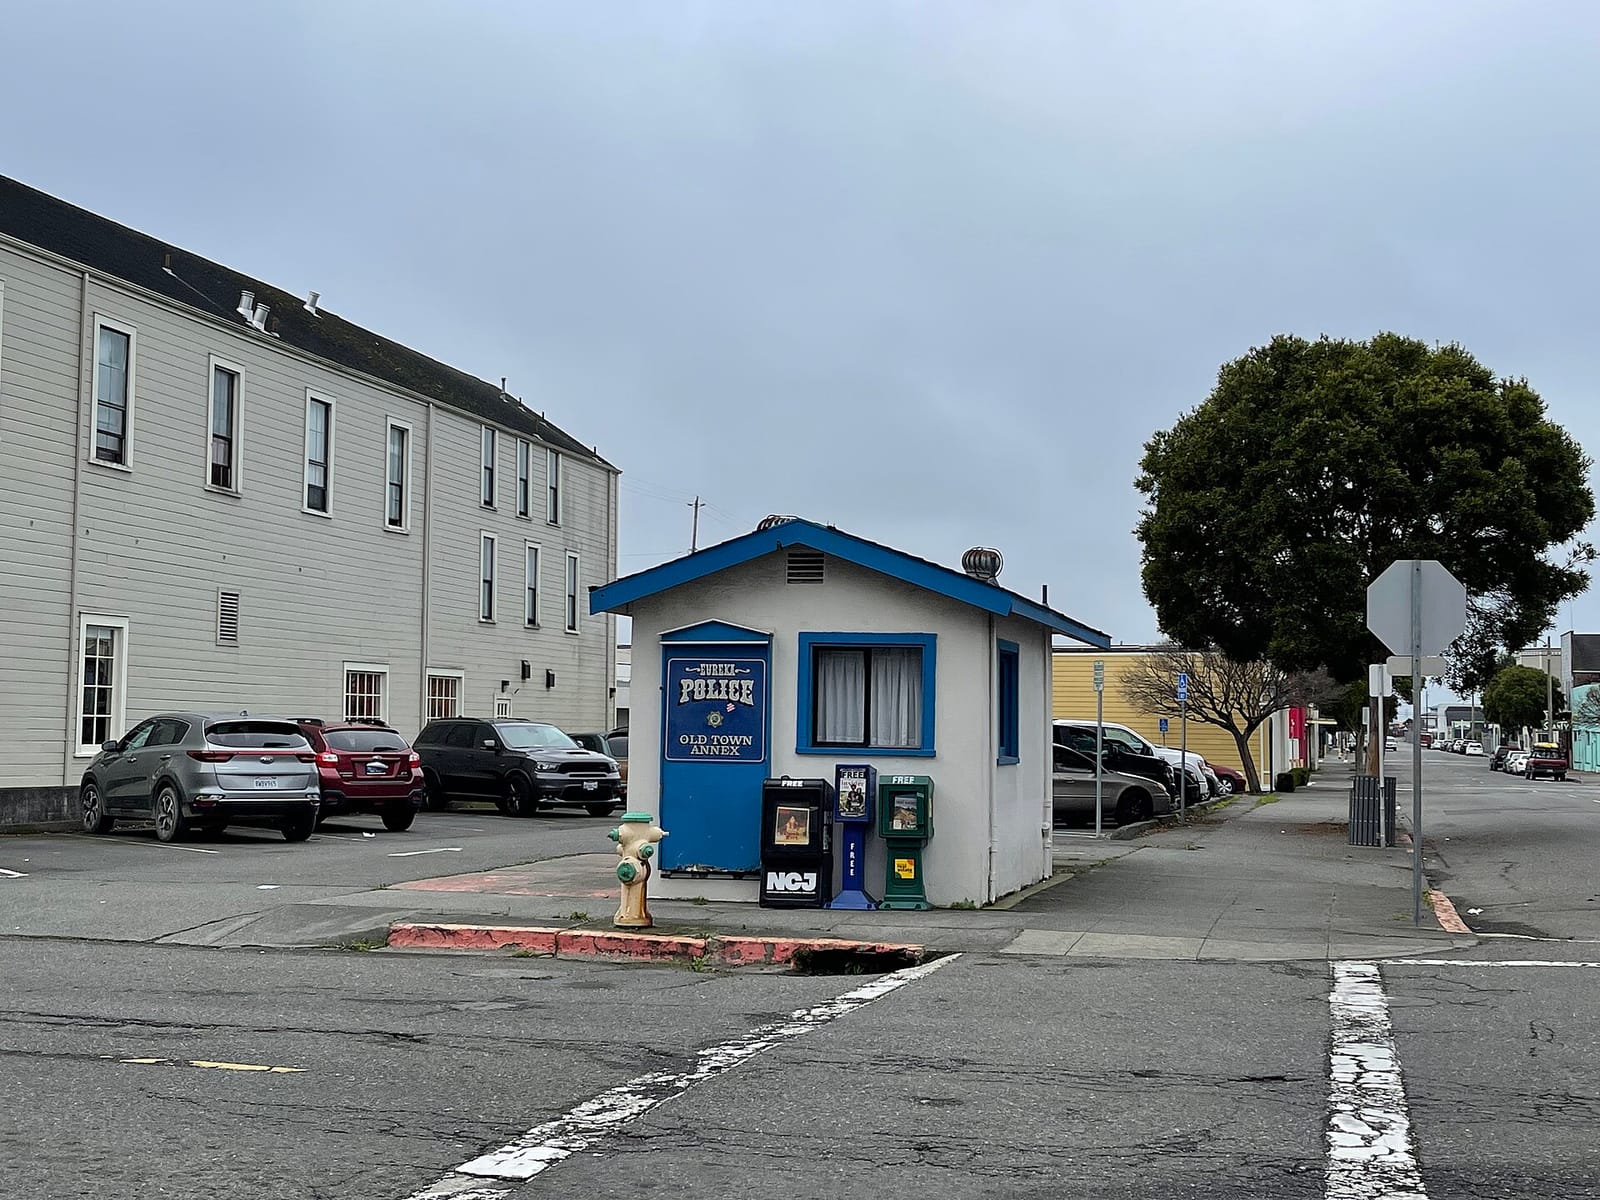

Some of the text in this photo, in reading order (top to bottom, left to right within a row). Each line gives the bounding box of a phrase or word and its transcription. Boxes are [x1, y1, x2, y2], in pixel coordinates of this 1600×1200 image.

[700, 663, 736, 676] EUREKA
[679, 679, 755, 706] POLICE
[679, 734, 753, 746] OLD TOWN
[690, 745, 740, 756] ANNEX
[842, 771, 865, 779] FREE
[892, 776, 915, 785] FREE
[766, 871, 817, 892] NCJ
